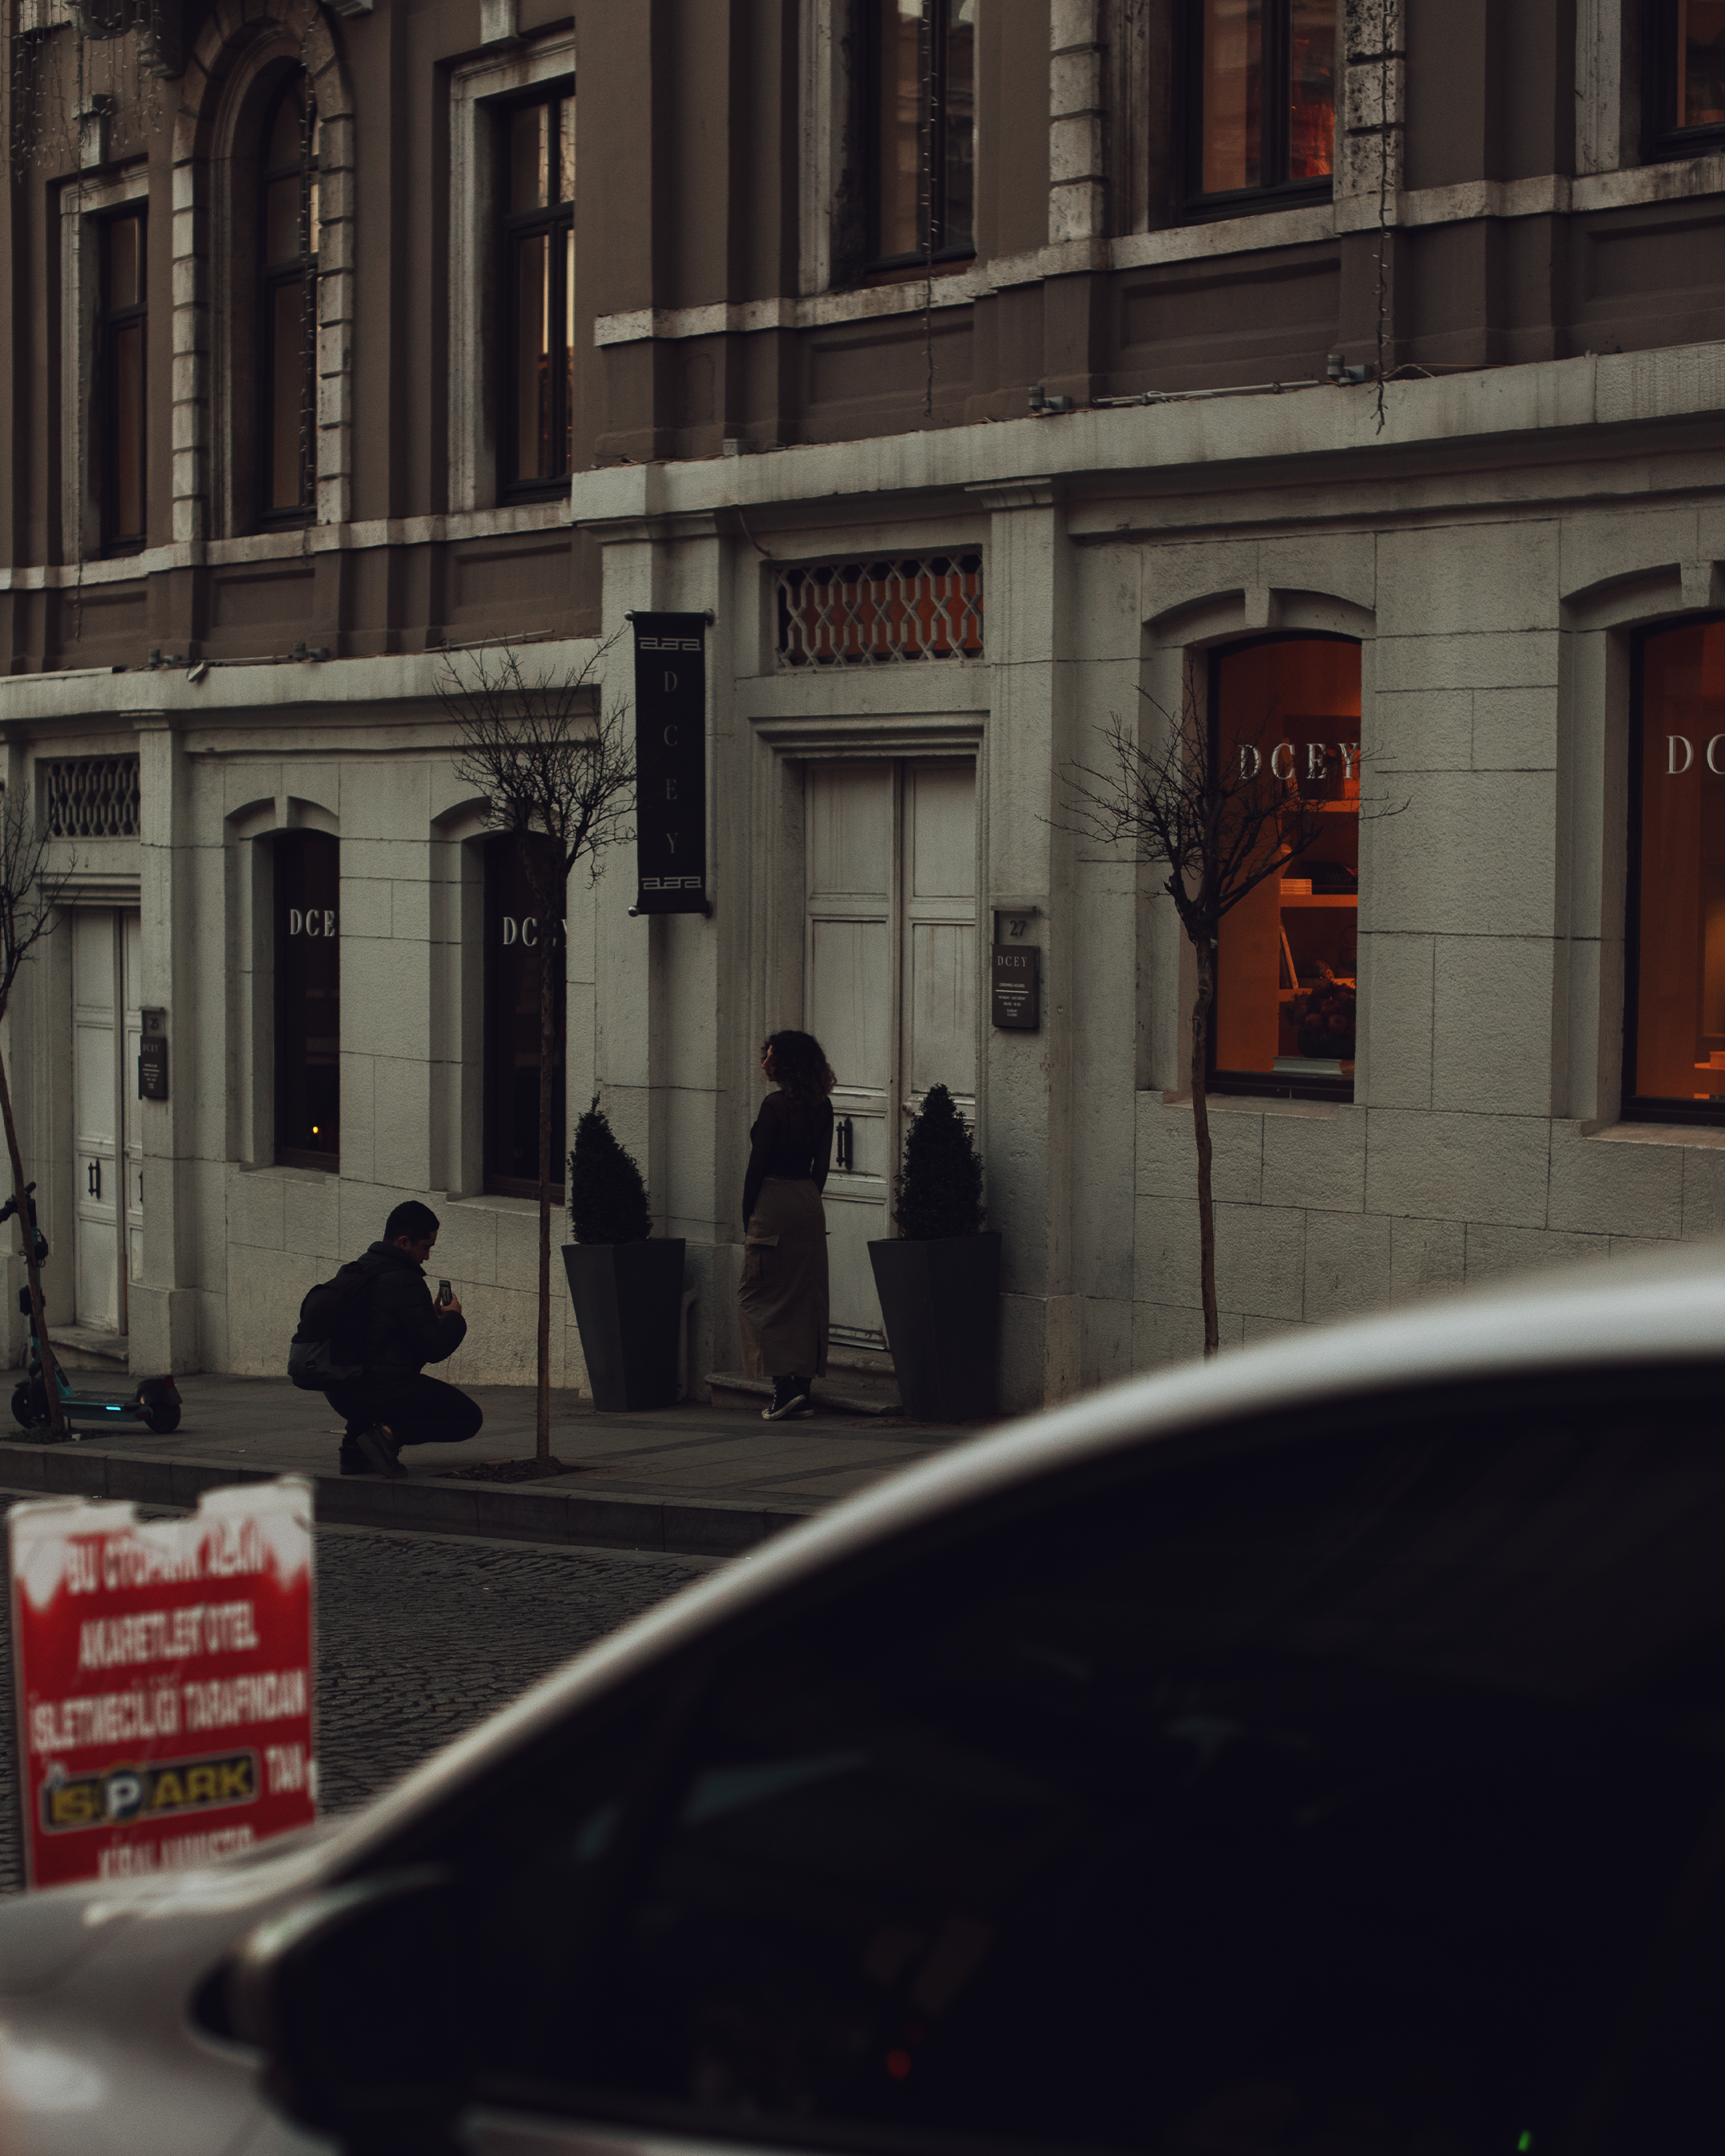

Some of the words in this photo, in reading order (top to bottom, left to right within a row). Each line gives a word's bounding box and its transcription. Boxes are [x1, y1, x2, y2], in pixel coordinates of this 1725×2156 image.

[663, 671, 678, 854] DCEY
[1238, 742, 1359, 780] DCEY
[502, 917, 566, 948] DC
[1009, 920, 1026, 937] 27
[997, 955, 1027, 967] DCEY
